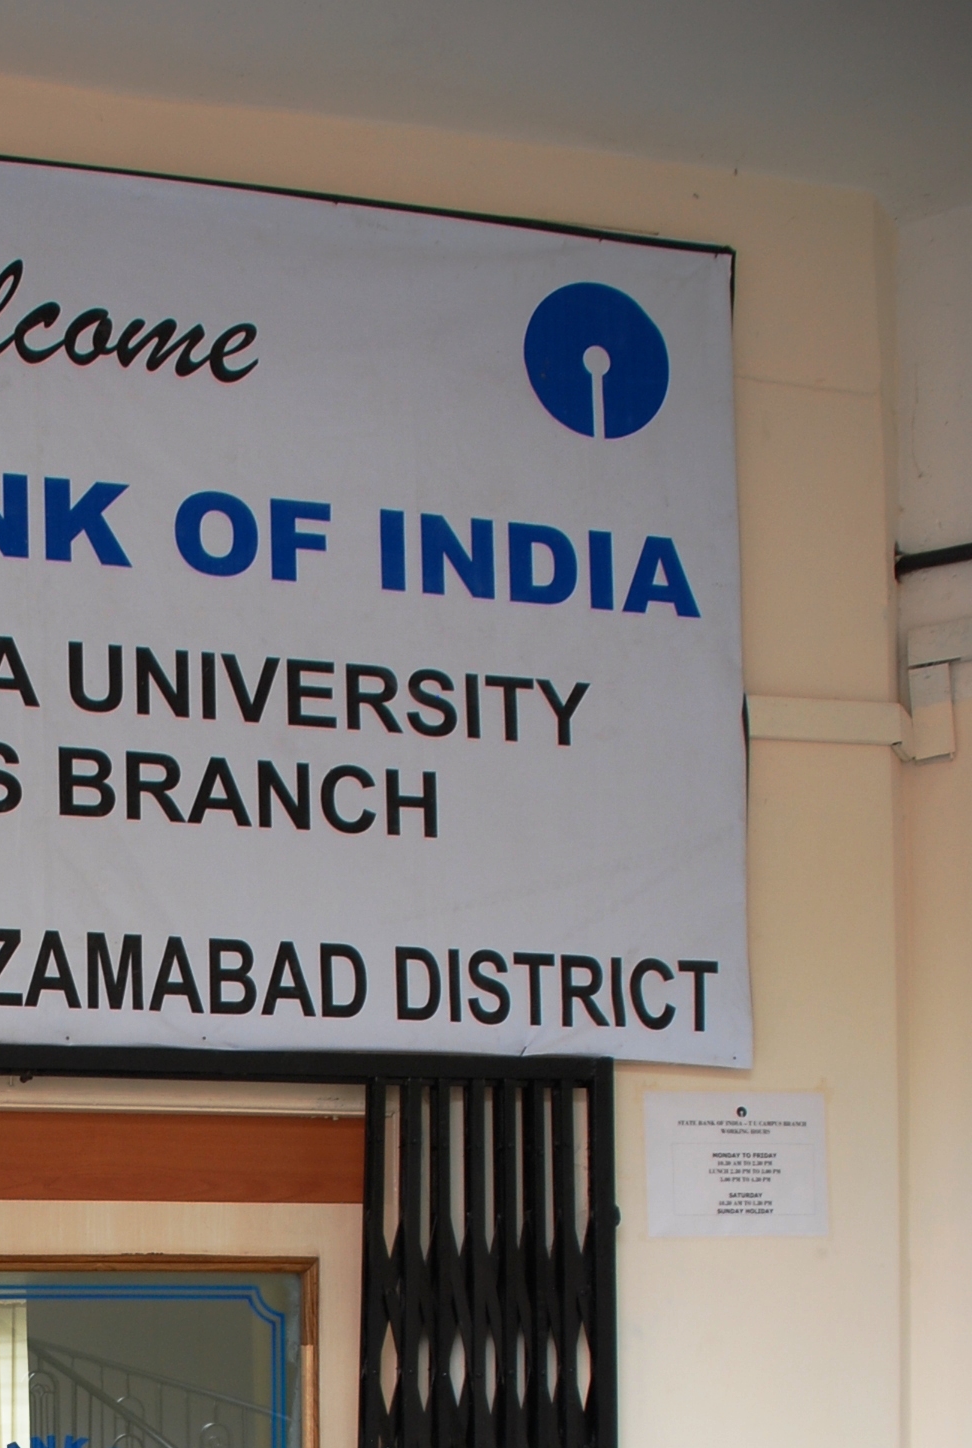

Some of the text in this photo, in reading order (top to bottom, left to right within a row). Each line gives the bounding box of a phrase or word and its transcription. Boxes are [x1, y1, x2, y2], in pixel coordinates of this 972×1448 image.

[175, 491, 331, 581] OF
[380, 508, 701, 618] INDIA
[68, 641, 590, 746] UNIVERSITY
[58, 746, 437, 838] BRANCH
[395, 946, 718, 1032] DISTRICT
